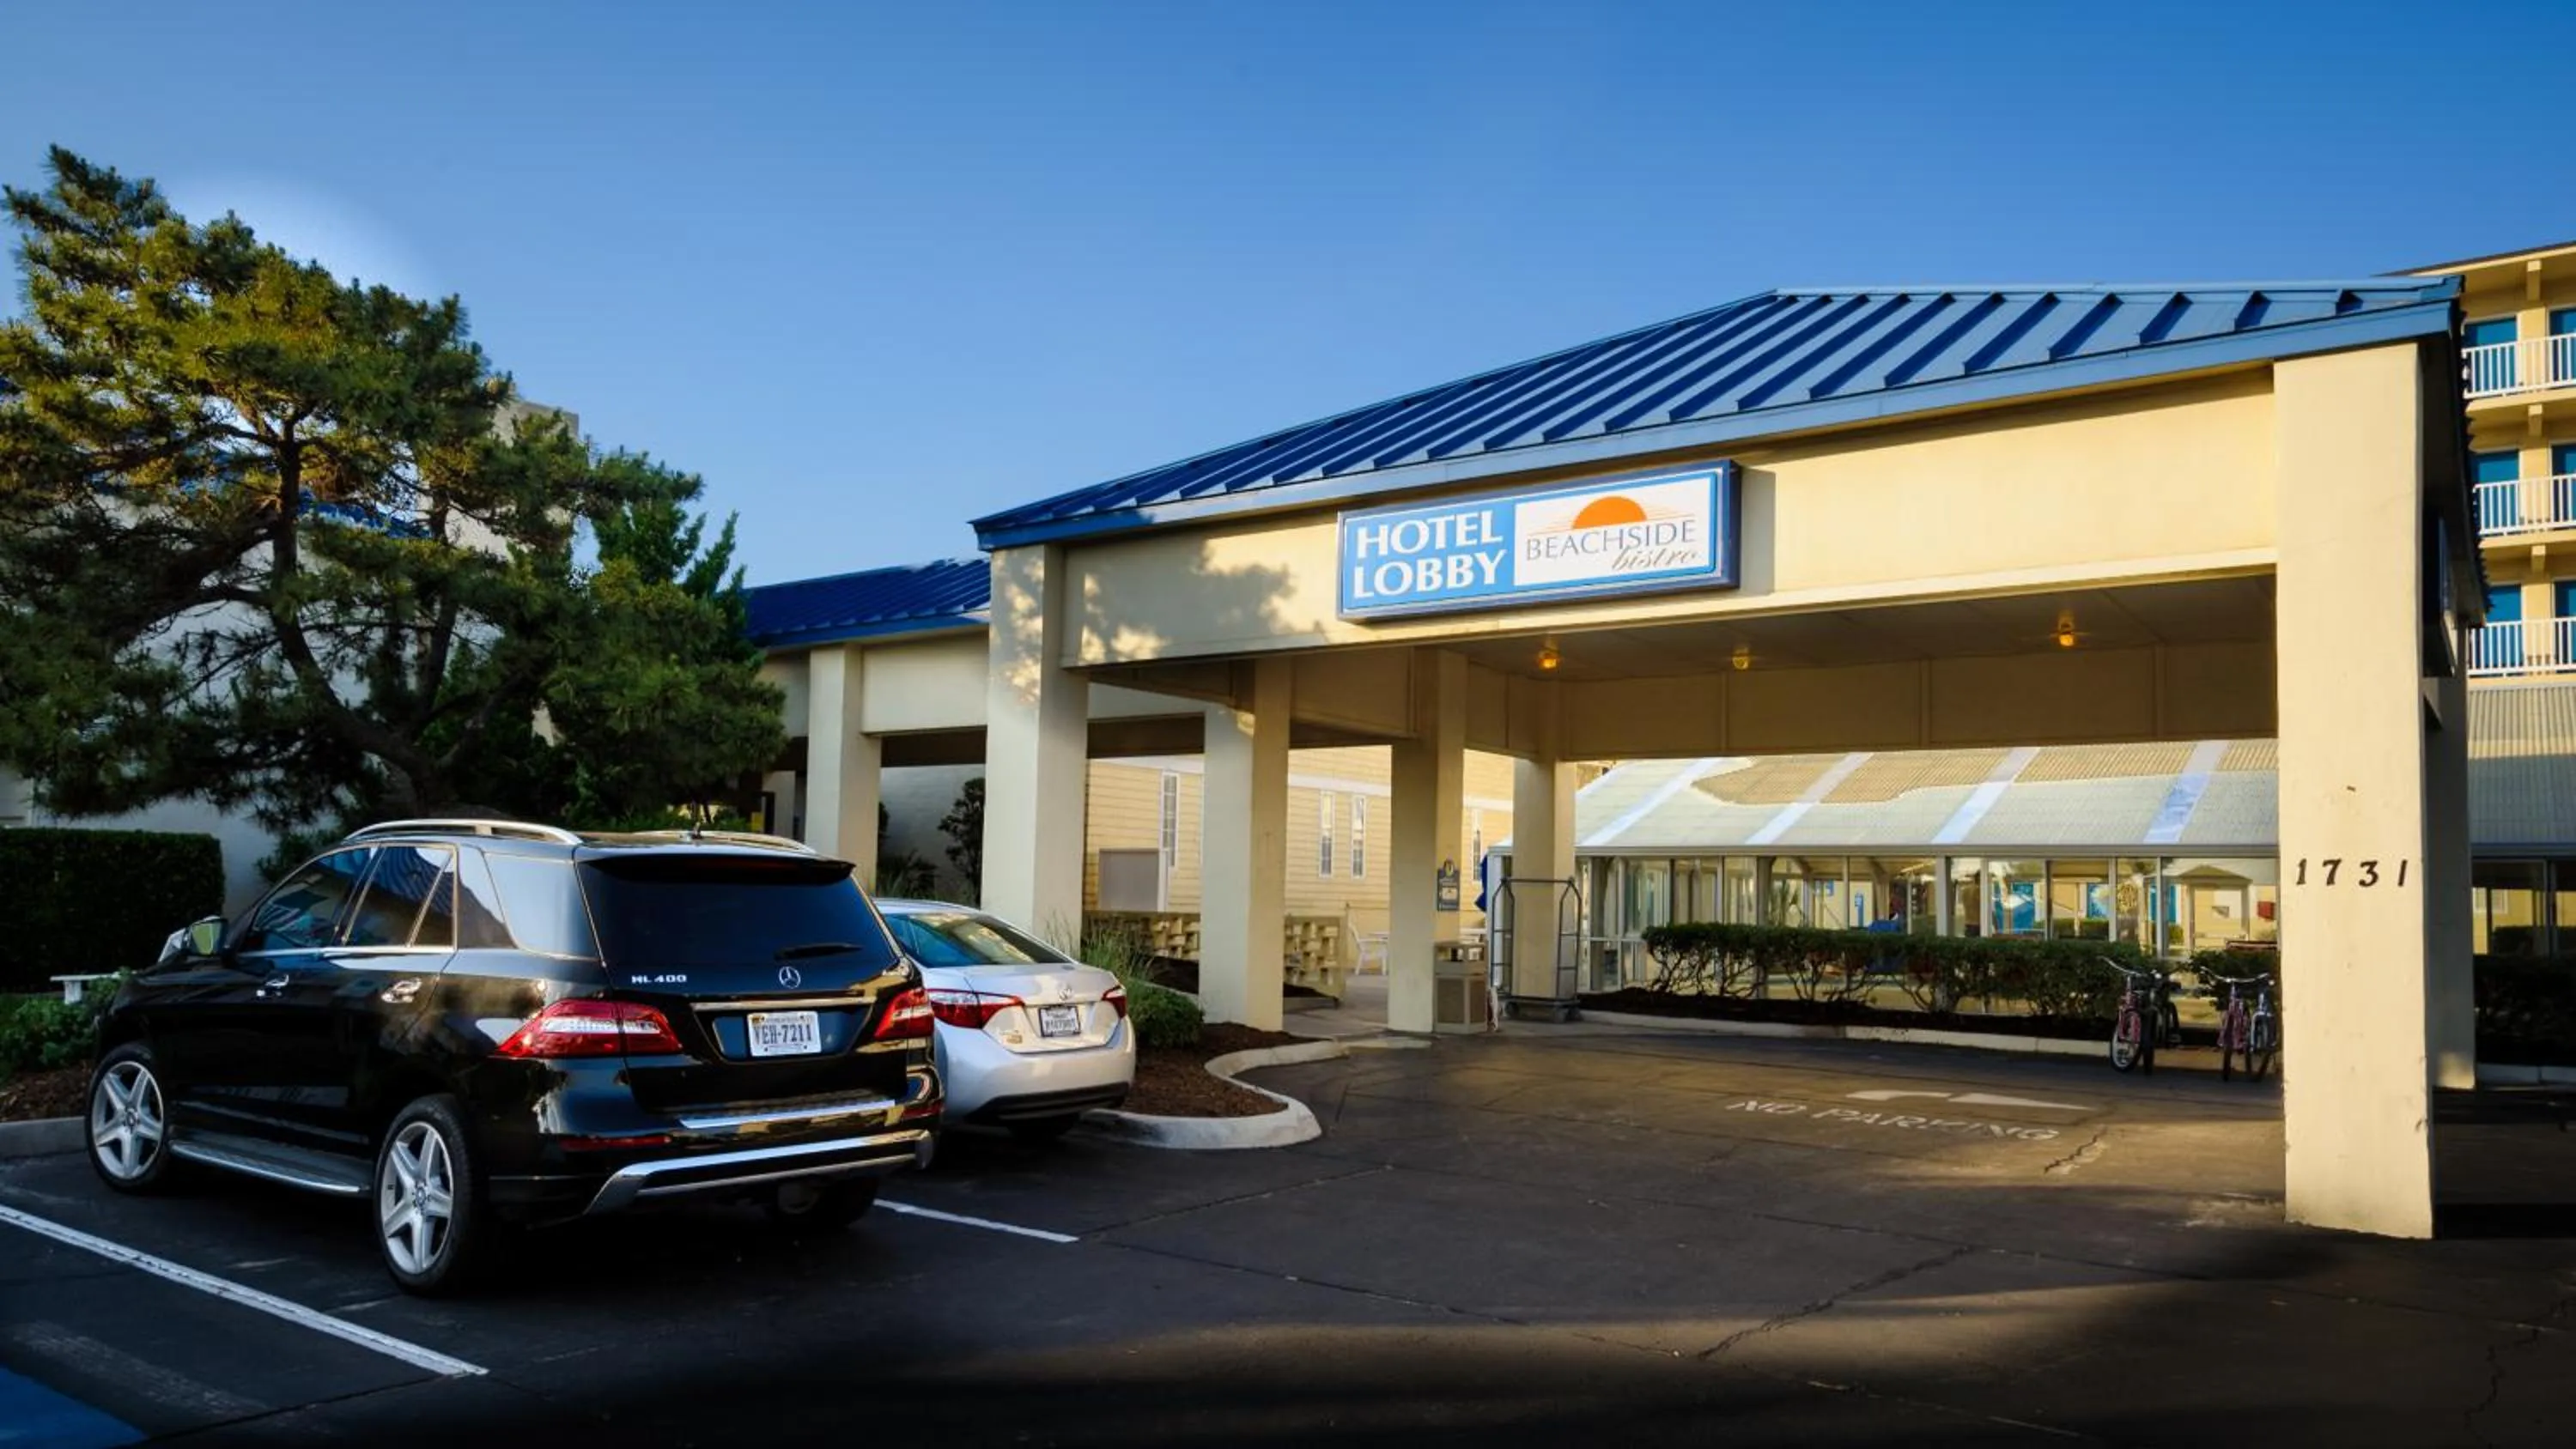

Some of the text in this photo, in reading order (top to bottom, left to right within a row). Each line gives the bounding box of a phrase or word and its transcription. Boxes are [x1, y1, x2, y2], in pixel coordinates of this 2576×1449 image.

[1358, 510, 1504, 559] HOTEL
[1526, 518, 1697, 561] BEACHSIDE
[1352, 548, 1507, 600] LOBBY
[1612, 546, 1701, 572] bistro
[2296, 858, 2408, 887] 1731
[654, 974, 688, 983] 400
[1725, 1100, 2059, 1140] NO PARKING
